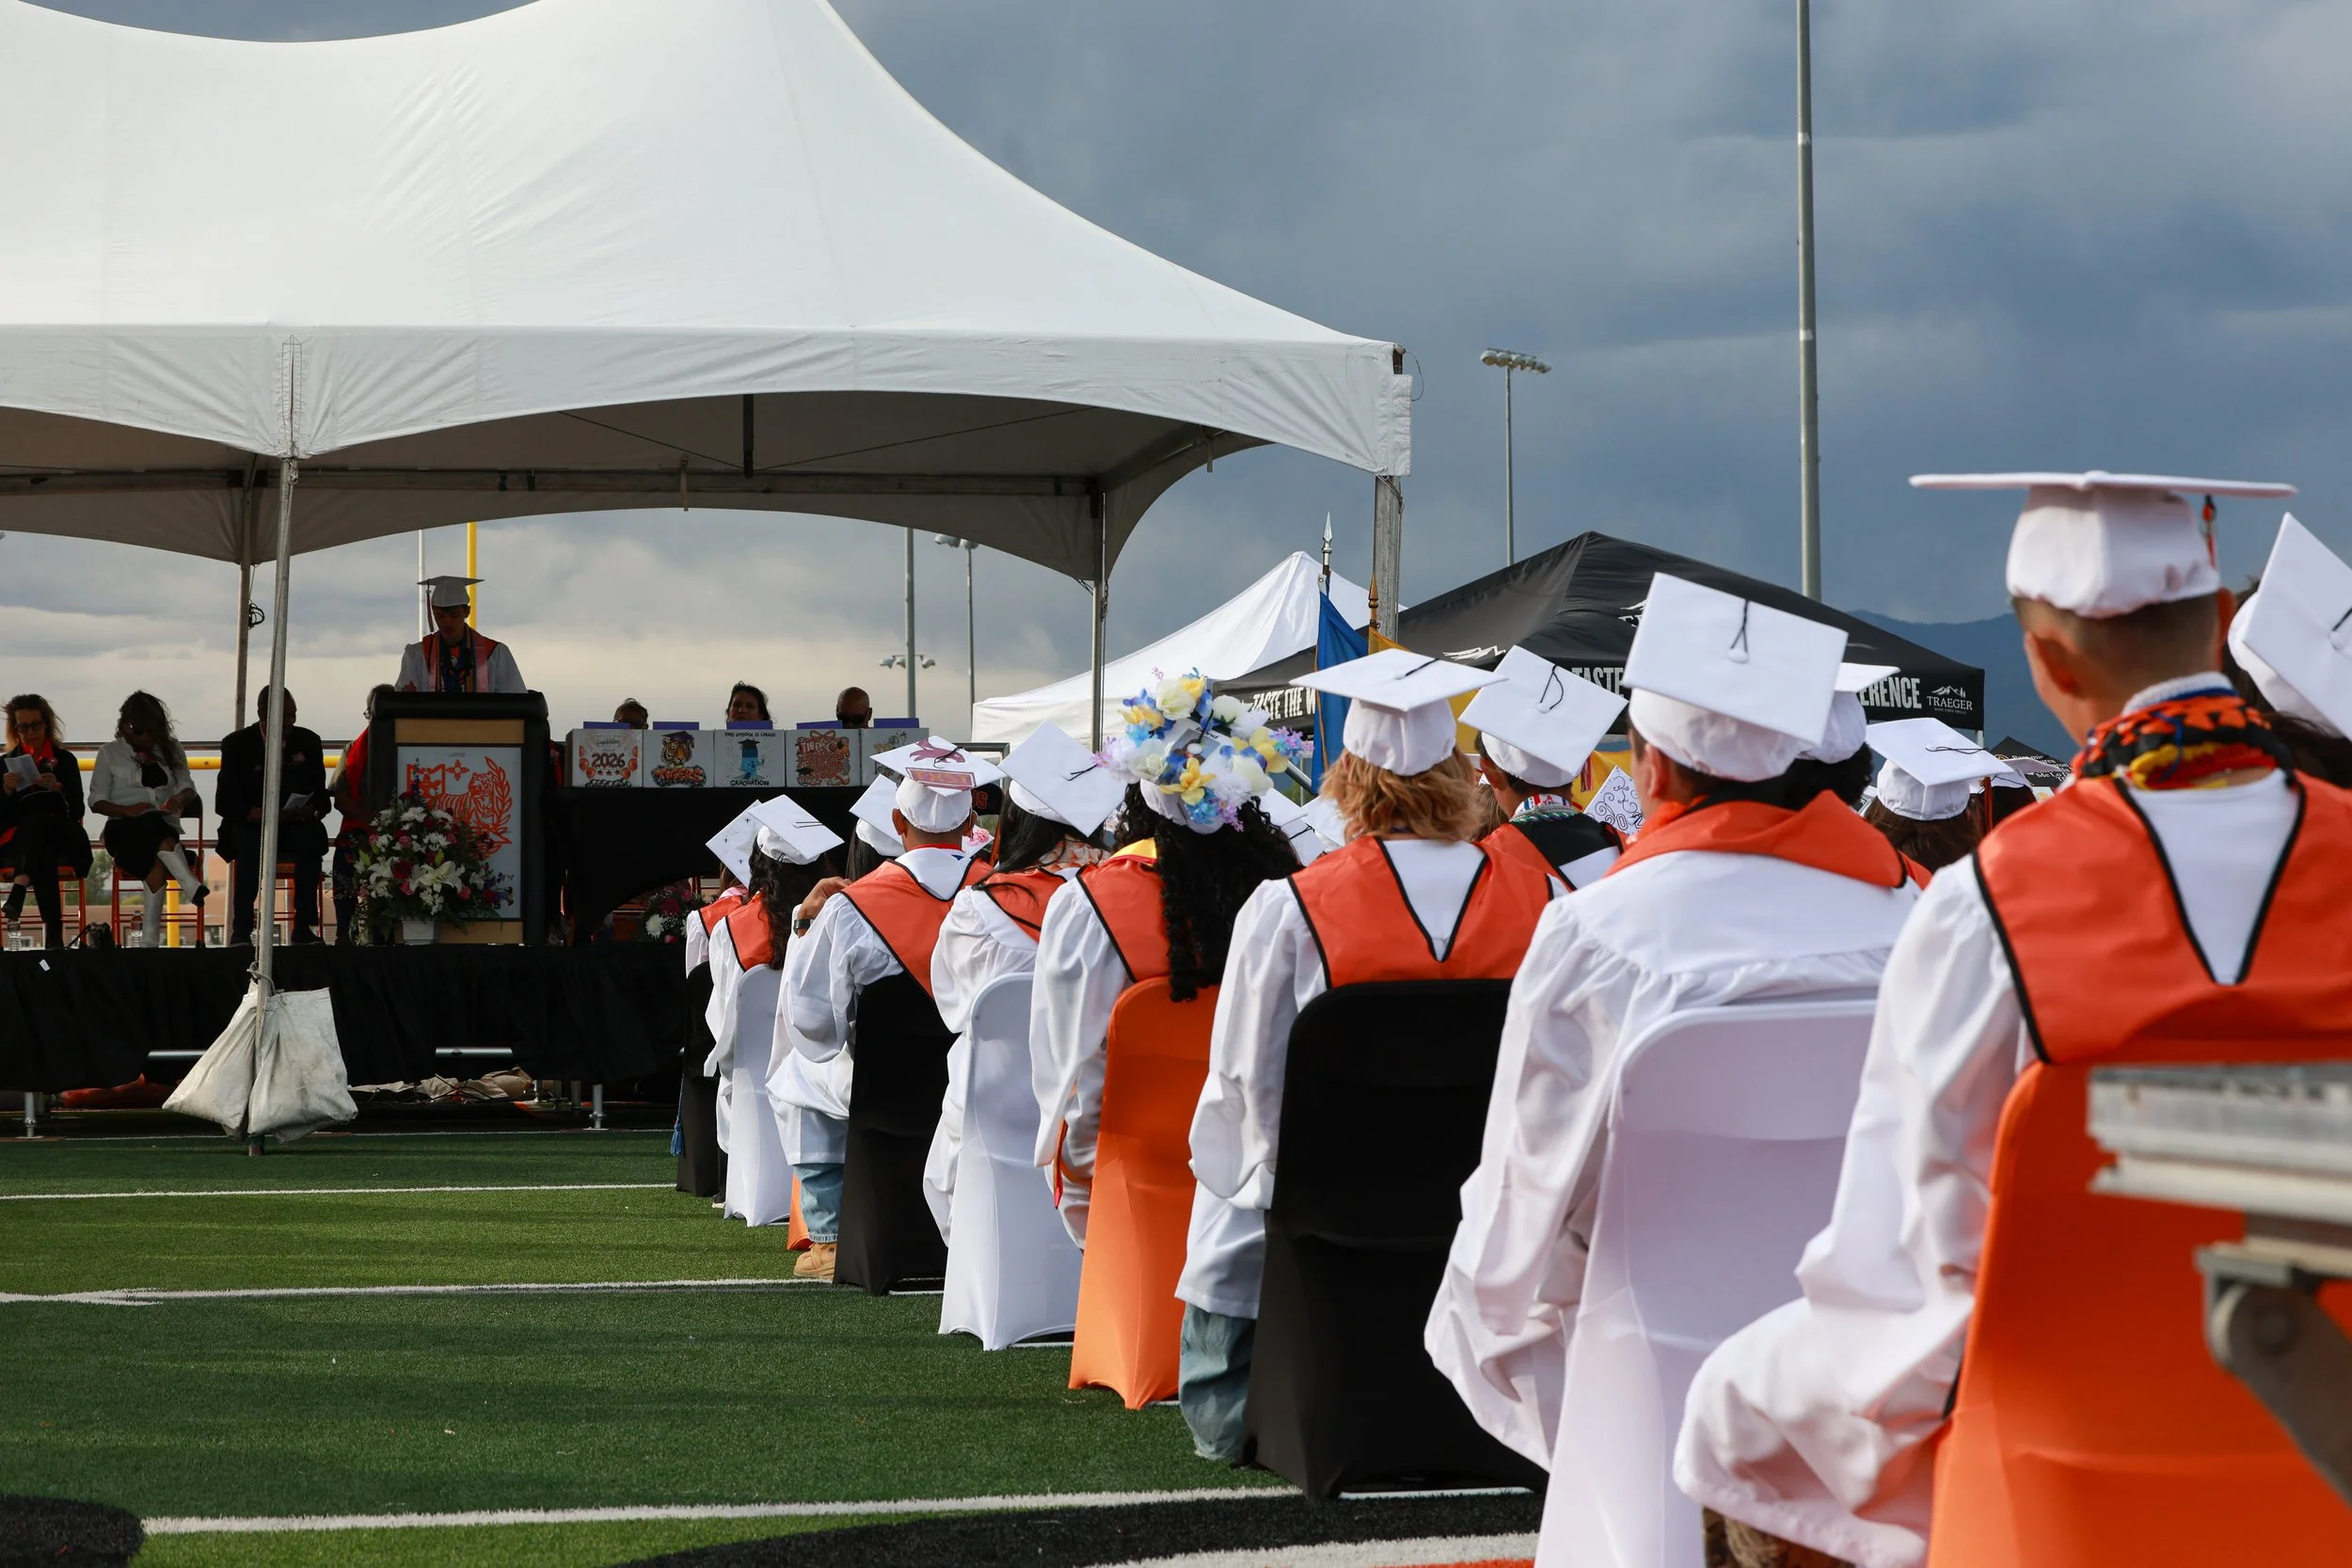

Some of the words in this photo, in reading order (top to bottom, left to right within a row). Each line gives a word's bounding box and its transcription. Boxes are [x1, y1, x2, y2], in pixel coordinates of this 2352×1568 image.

[1571, 667, 1625, 697] STE
[1251, 689, 1284, 721] TASTE
[1284, 687, 1305, 718] THE
[1927, 696, 1973, 711] TRAEGER
[592, 752, 626, 768] 2026
[653, 767, 706, 784] TIGERS
